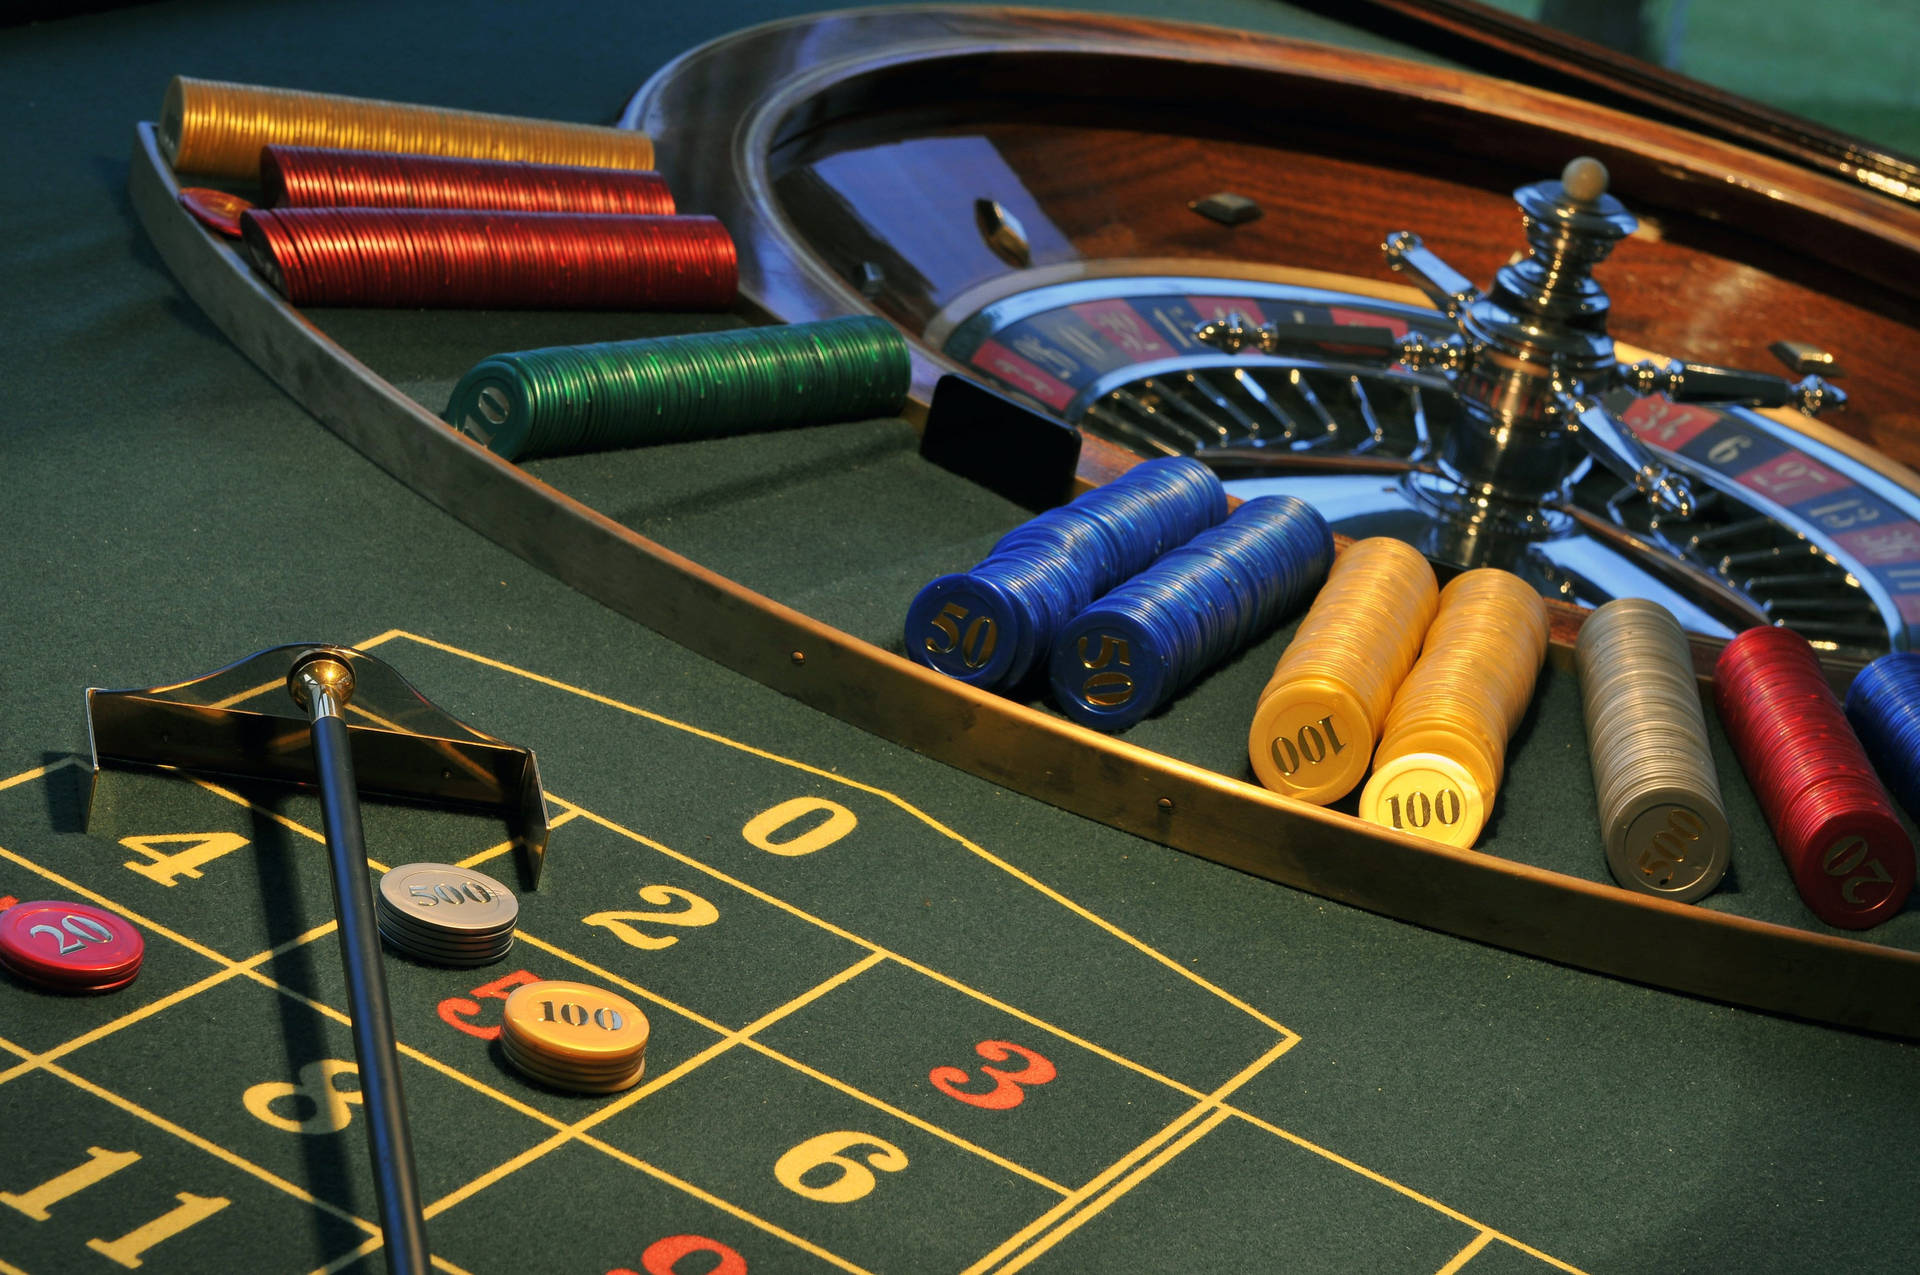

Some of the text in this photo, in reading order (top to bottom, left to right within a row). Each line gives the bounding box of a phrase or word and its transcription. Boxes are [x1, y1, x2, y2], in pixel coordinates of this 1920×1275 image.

[461, 386, 511, 449] 10
[1706, 434, 1753, 465] 6
[925, 601, 998, 669] 50
[1077, 635, 1135, 706] 50
[1271, 714, 1347, 777] 100
[742, 796, 858, 856] 0
[1384, 788, 1461, 830] 100
[118, 832, 251, 888] 4
[1637, 809, 1704, 882] 500
[1822, 845, 1894, 904] 20
[408, 881, 492, 907] 500
[582, 885, 720, 950] 2
[30, 914, 114, 957] 20
[536, 1000, 623, 1031] 100
[929, 1039, 1057, 1110] 3
[774, 1131, 909, 1203] 6
[0, 1145, 232, 1270] 11
